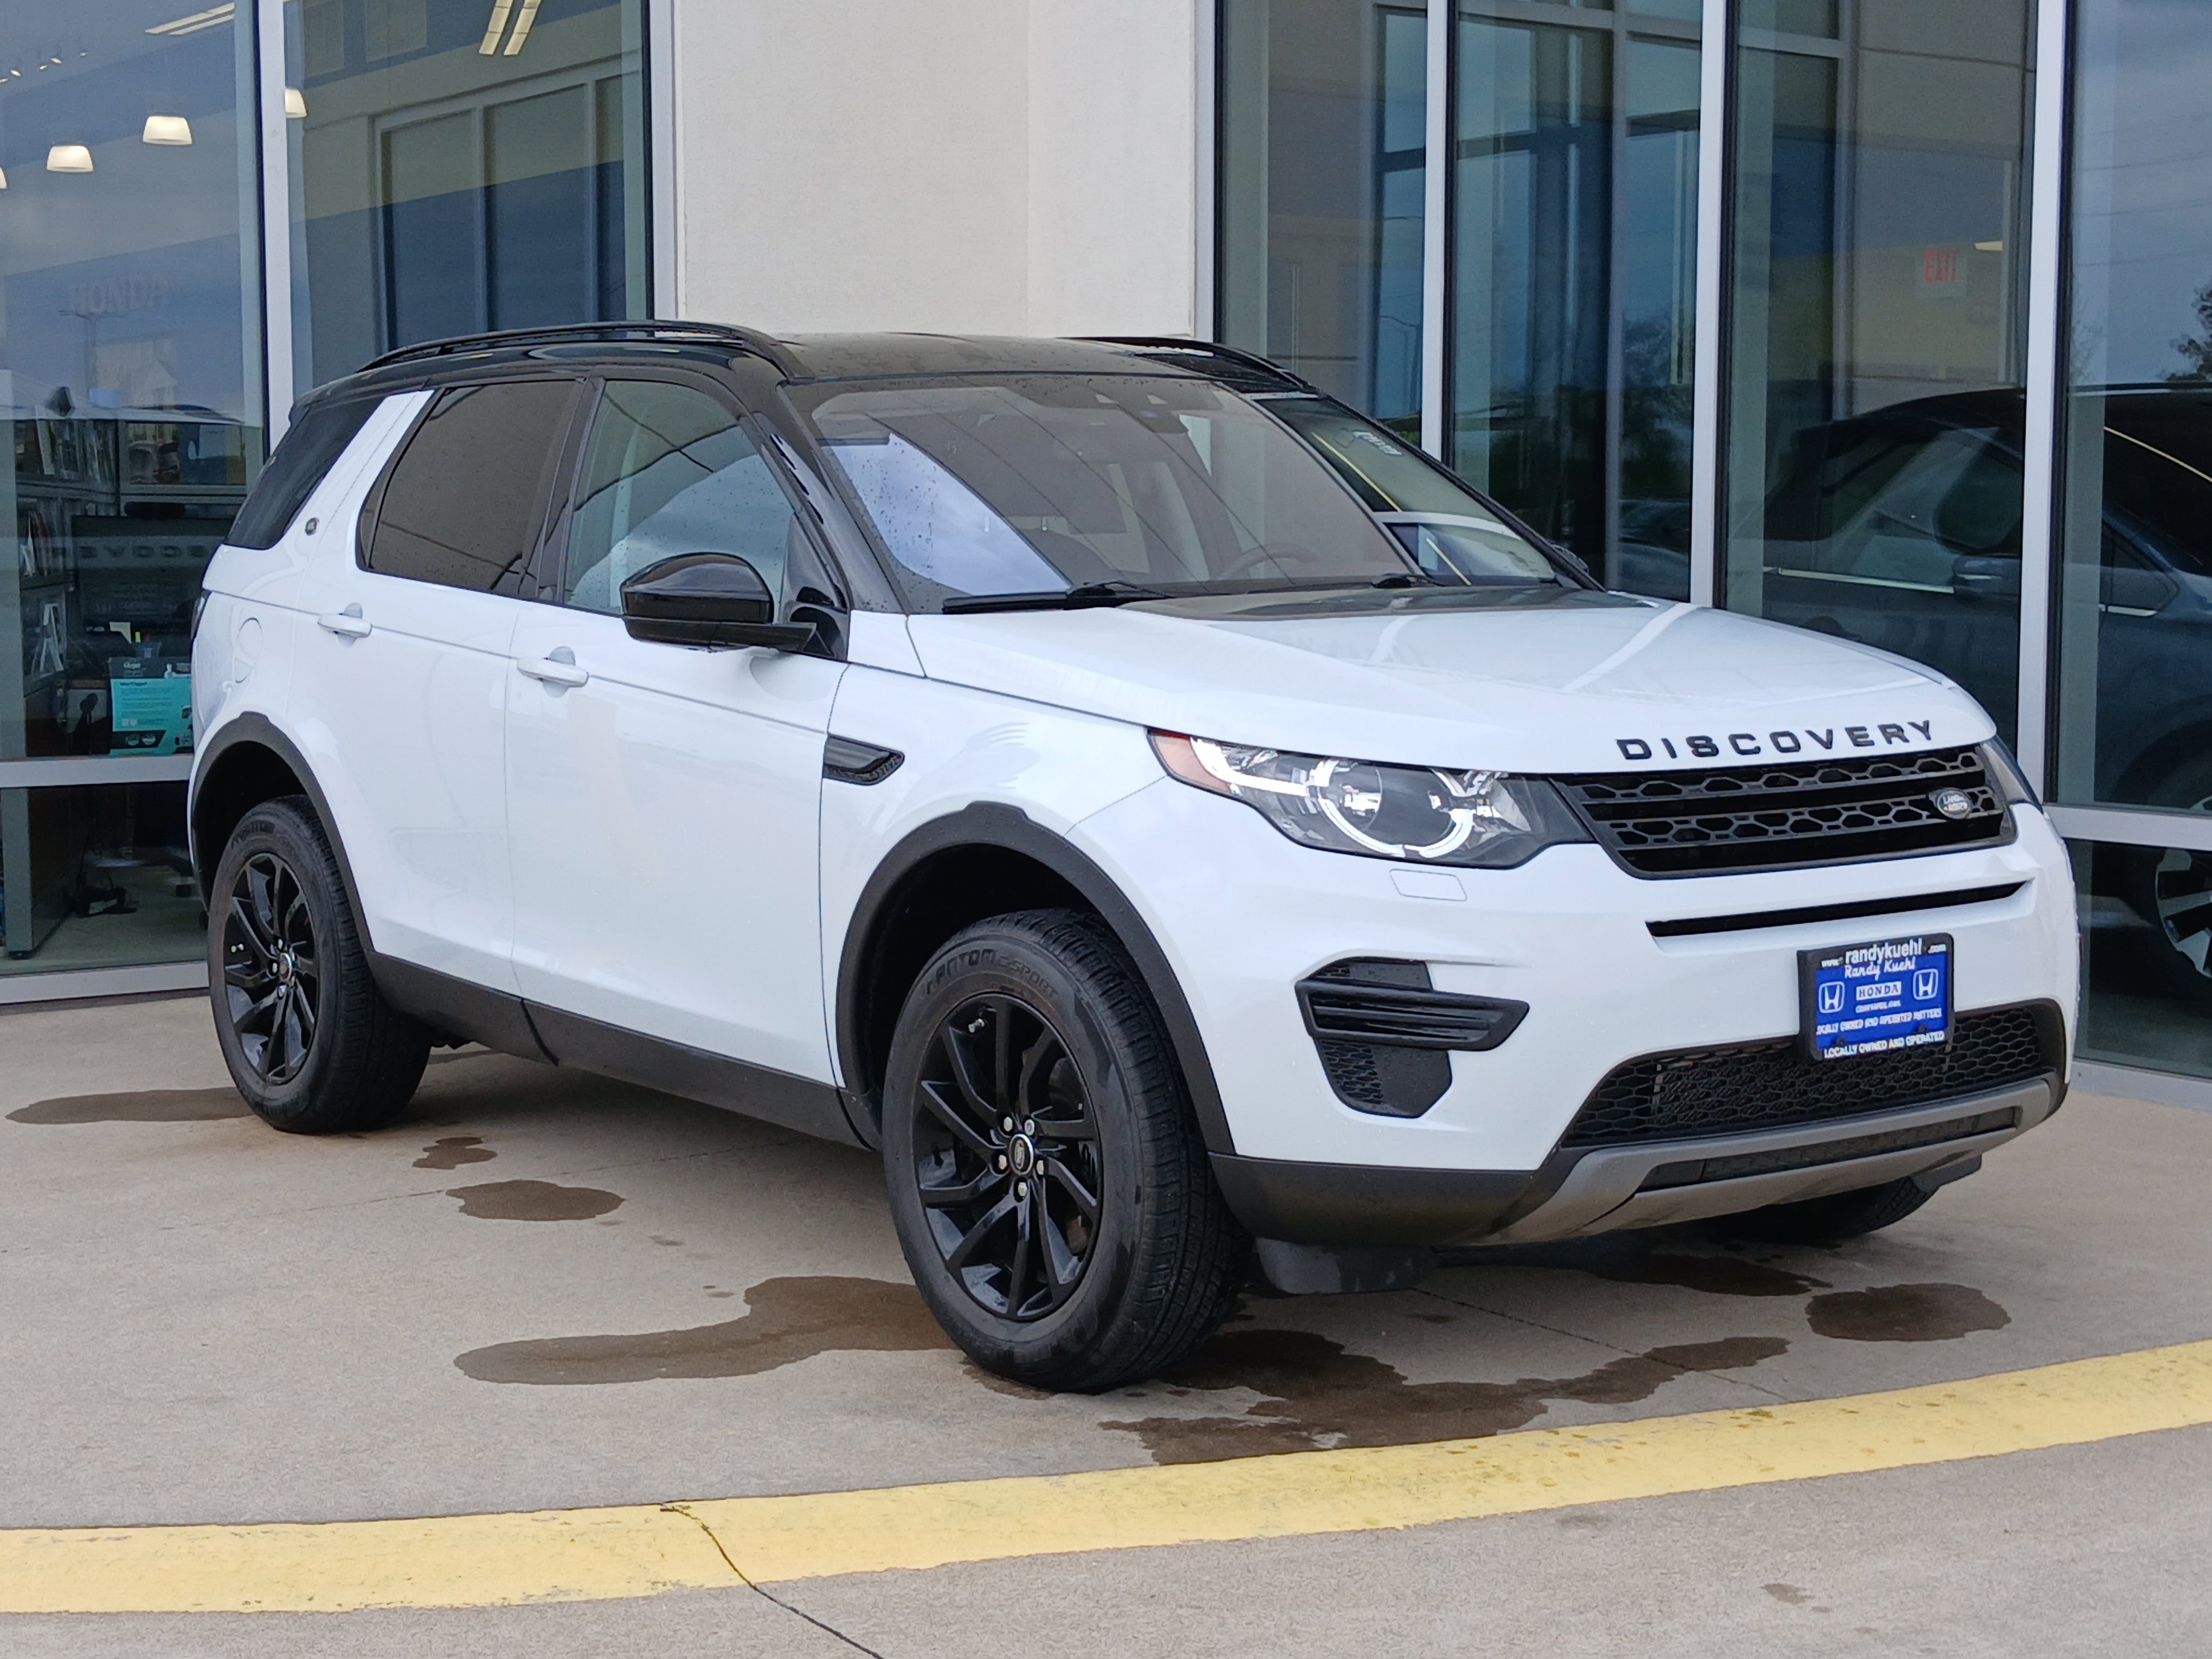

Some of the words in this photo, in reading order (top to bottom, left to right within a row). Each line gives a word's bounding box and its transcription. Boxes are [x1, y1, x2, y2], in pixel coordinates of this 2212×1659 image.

[1925, 248, 1960, 284] EXIT
[1615, 720, 1932, 760] DISCOVERY
[1845, 937, 1922, 964] randykuehl
[1844, 961, 1881, 981] Randy
[1884, 956, 1916, 973] Kuehl
[1858, 984, 1899, 998] HONDA
[1824, 1044, 1857, 1059] LOCALLY
[1859, 1040, 1887, 1053] OWNED
[1889, 1037, 1905, 1050] AND
[1906, 1031, 1945, 1046] OPERATED
